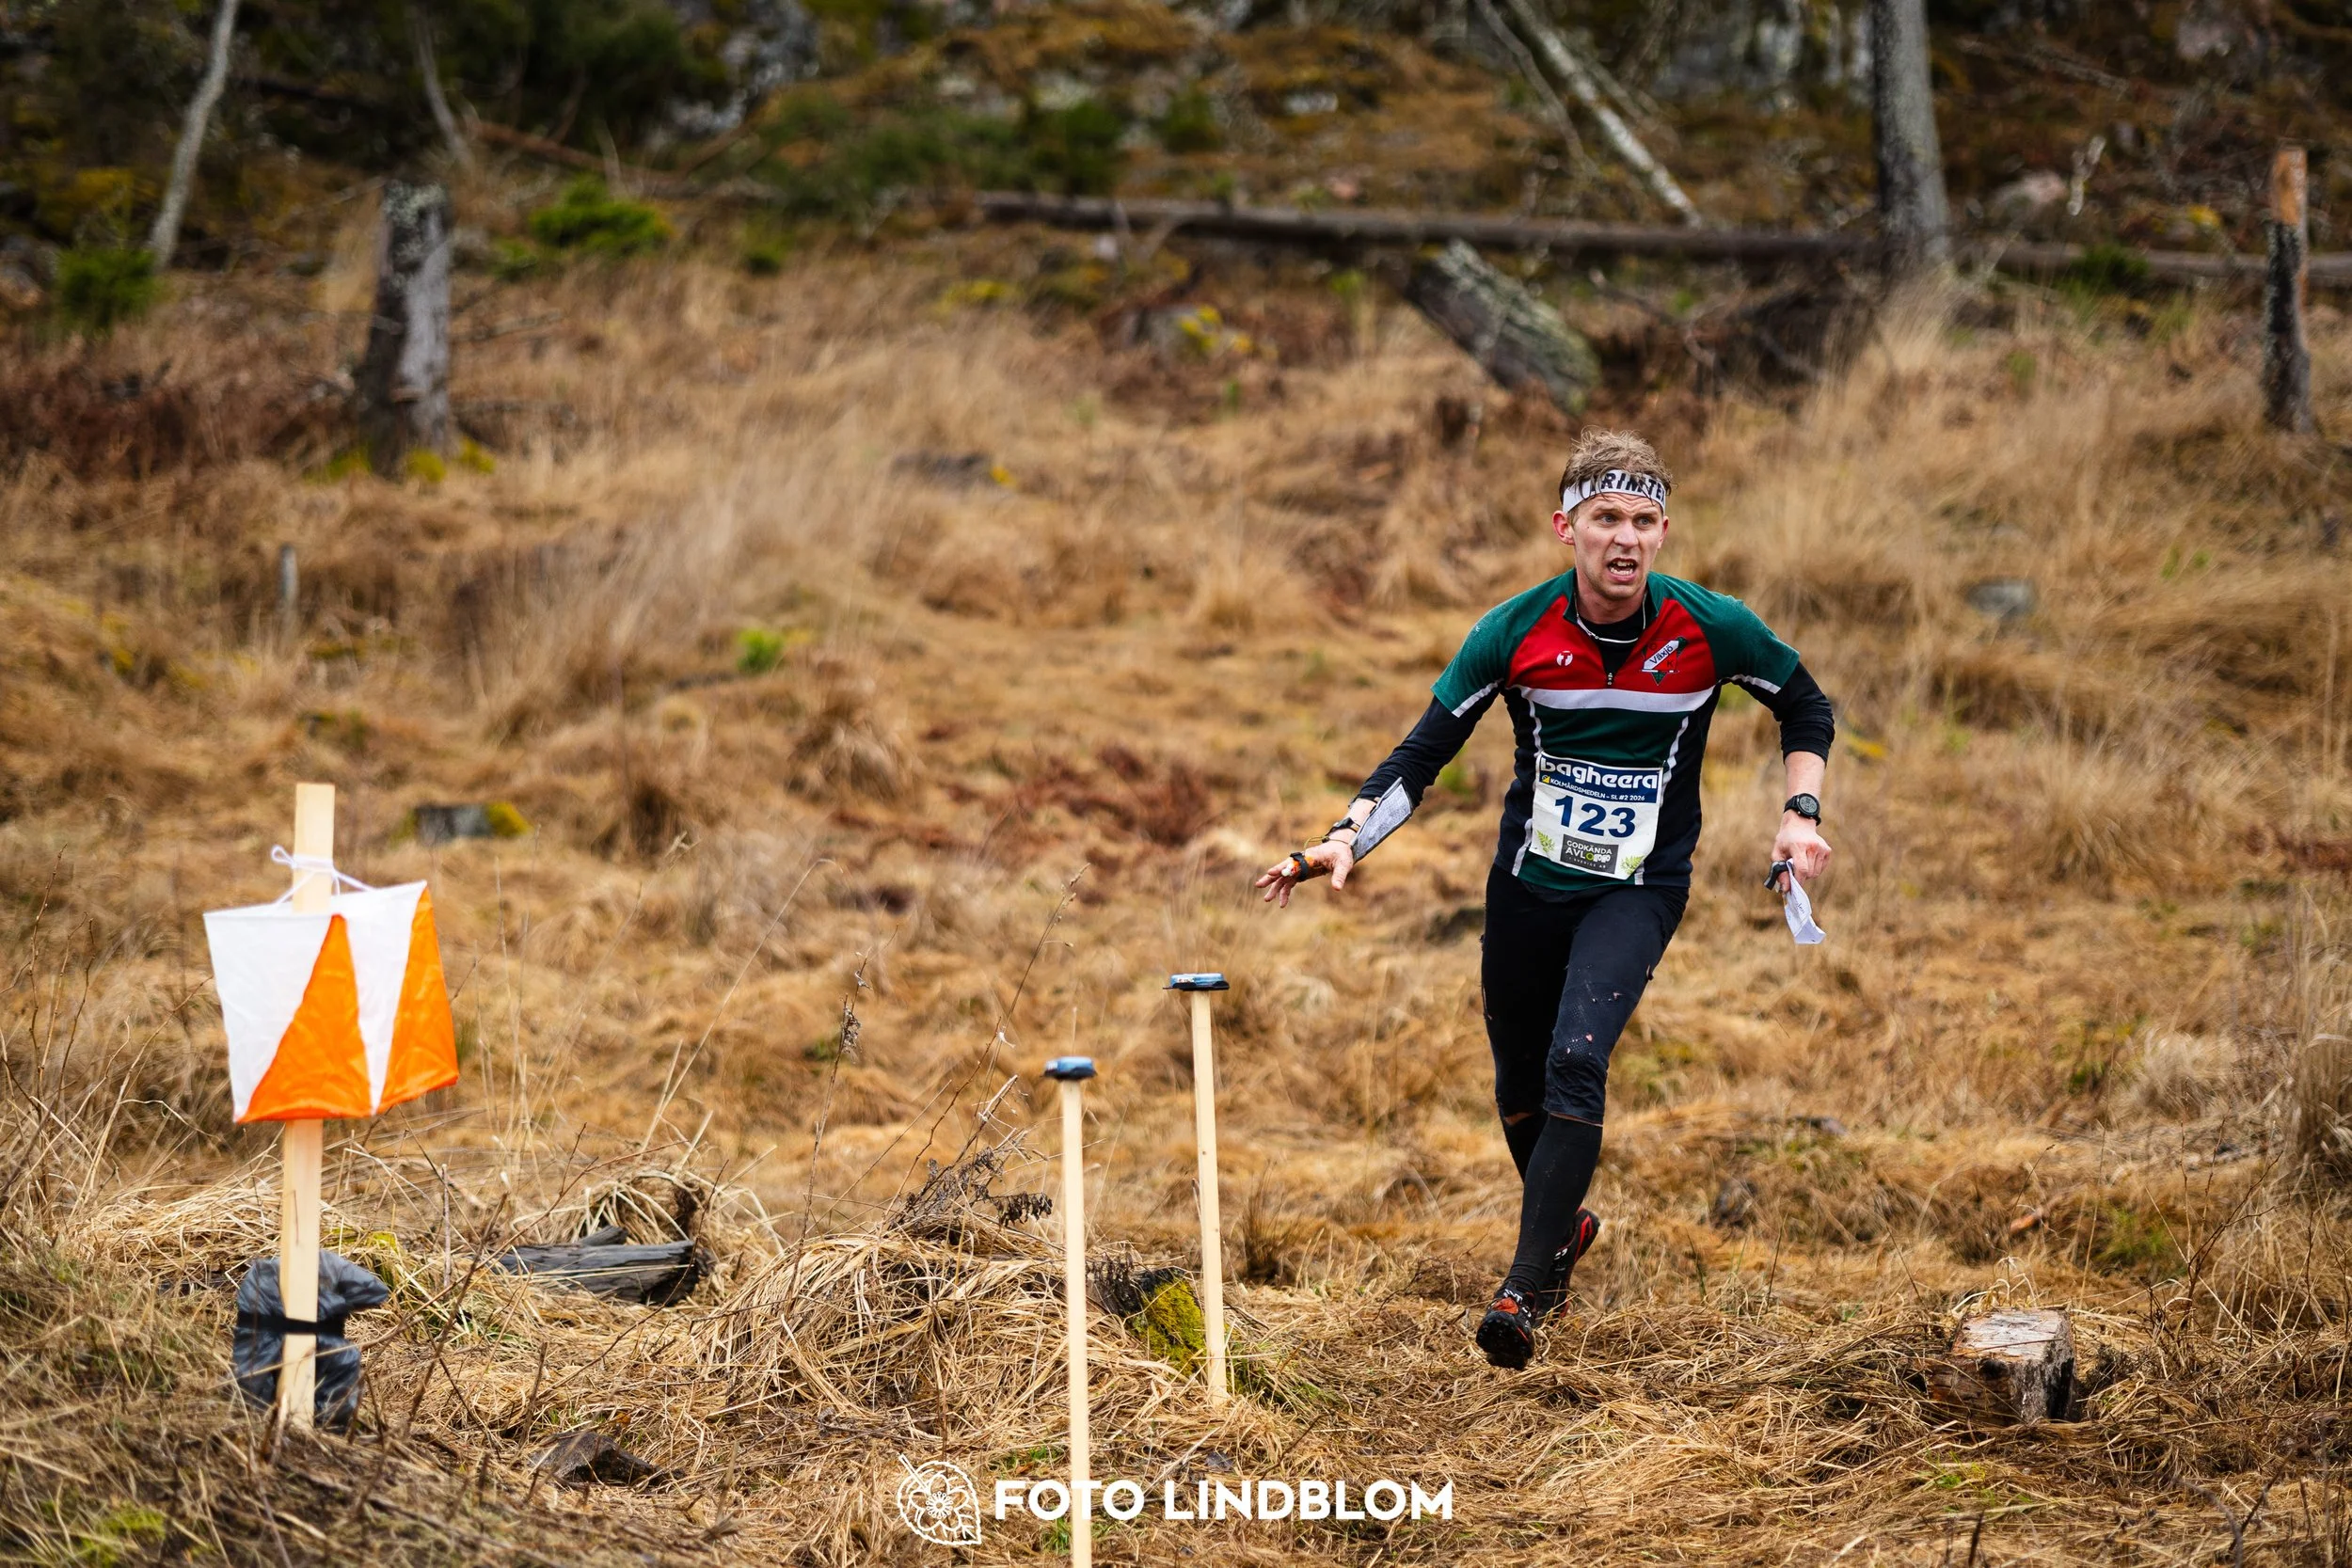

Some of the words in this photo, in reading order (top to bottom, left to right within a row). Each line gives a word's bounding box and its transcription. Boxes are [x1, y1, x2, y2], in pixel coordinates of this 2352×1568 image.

[1590, 472, 1665, 502] RIMTE
[1649, 644, 1674, 664] Växjö
[1540, 758, 1658, 789] bagheera
[1549, 778, 1606, 799] KOLMÅRDSMEDELN
[1554, 794, 1637, 838] 123
[1566, 840, 1613, 855] GODKÄNDA
